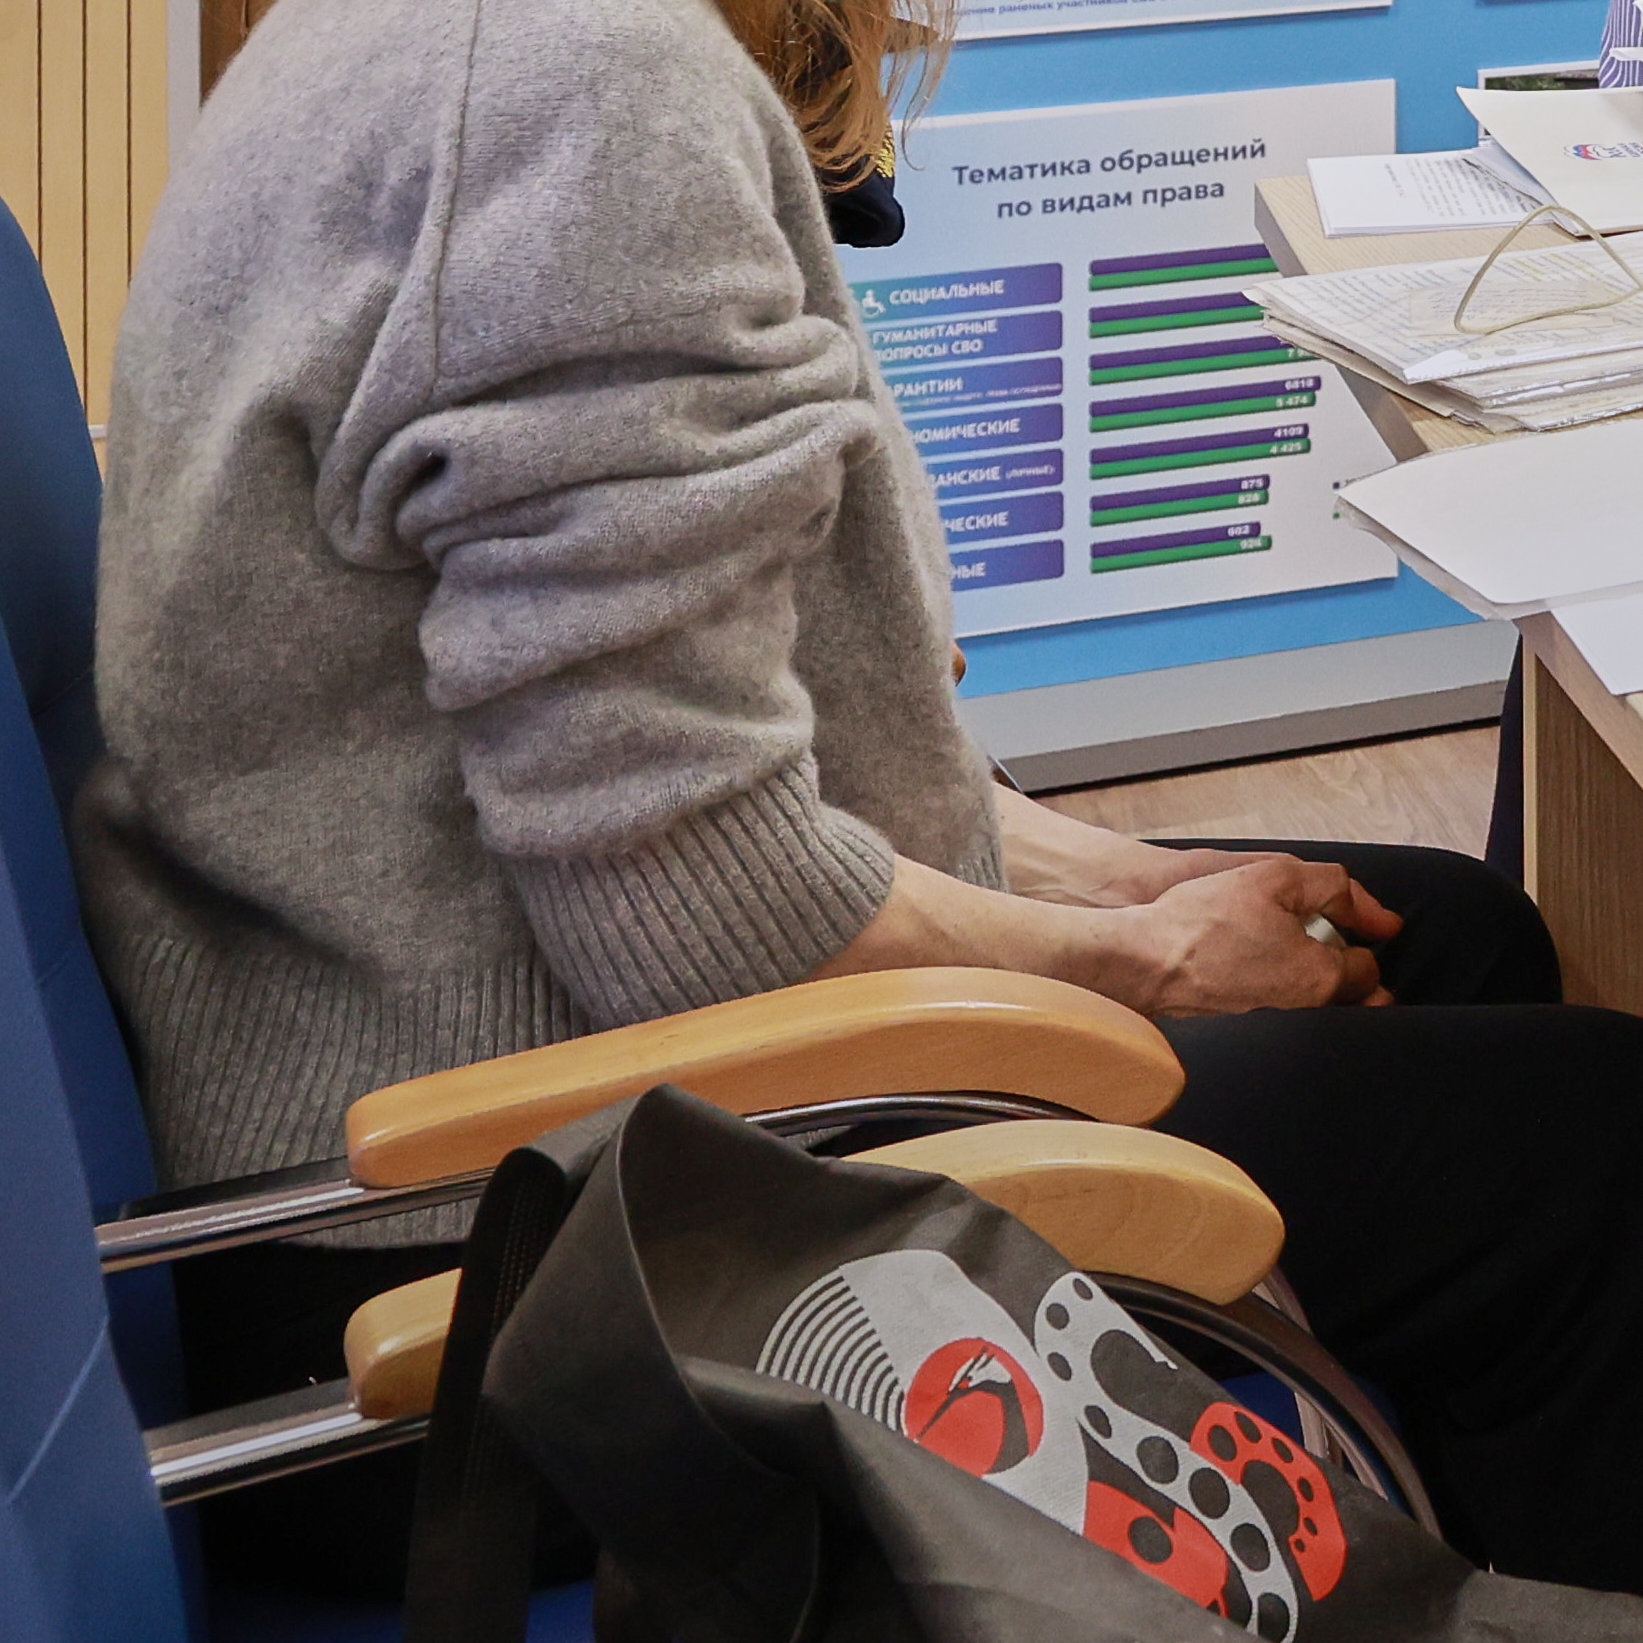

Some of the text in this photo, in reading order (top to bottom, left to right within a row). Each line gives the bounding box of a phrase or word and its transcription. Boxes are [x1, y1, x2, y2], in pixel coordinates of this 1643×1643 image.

[952, 138, 1267, 188] Тематика обращений
[997, 180, 1226, 220] по видам права
[889, 279, 1005, 306] СОЦИАЛЬНЫЕ
[872, 319, 997, 344] ГУМАНИТАРНЫЕ
[951, 339, 983, 354] СВО
